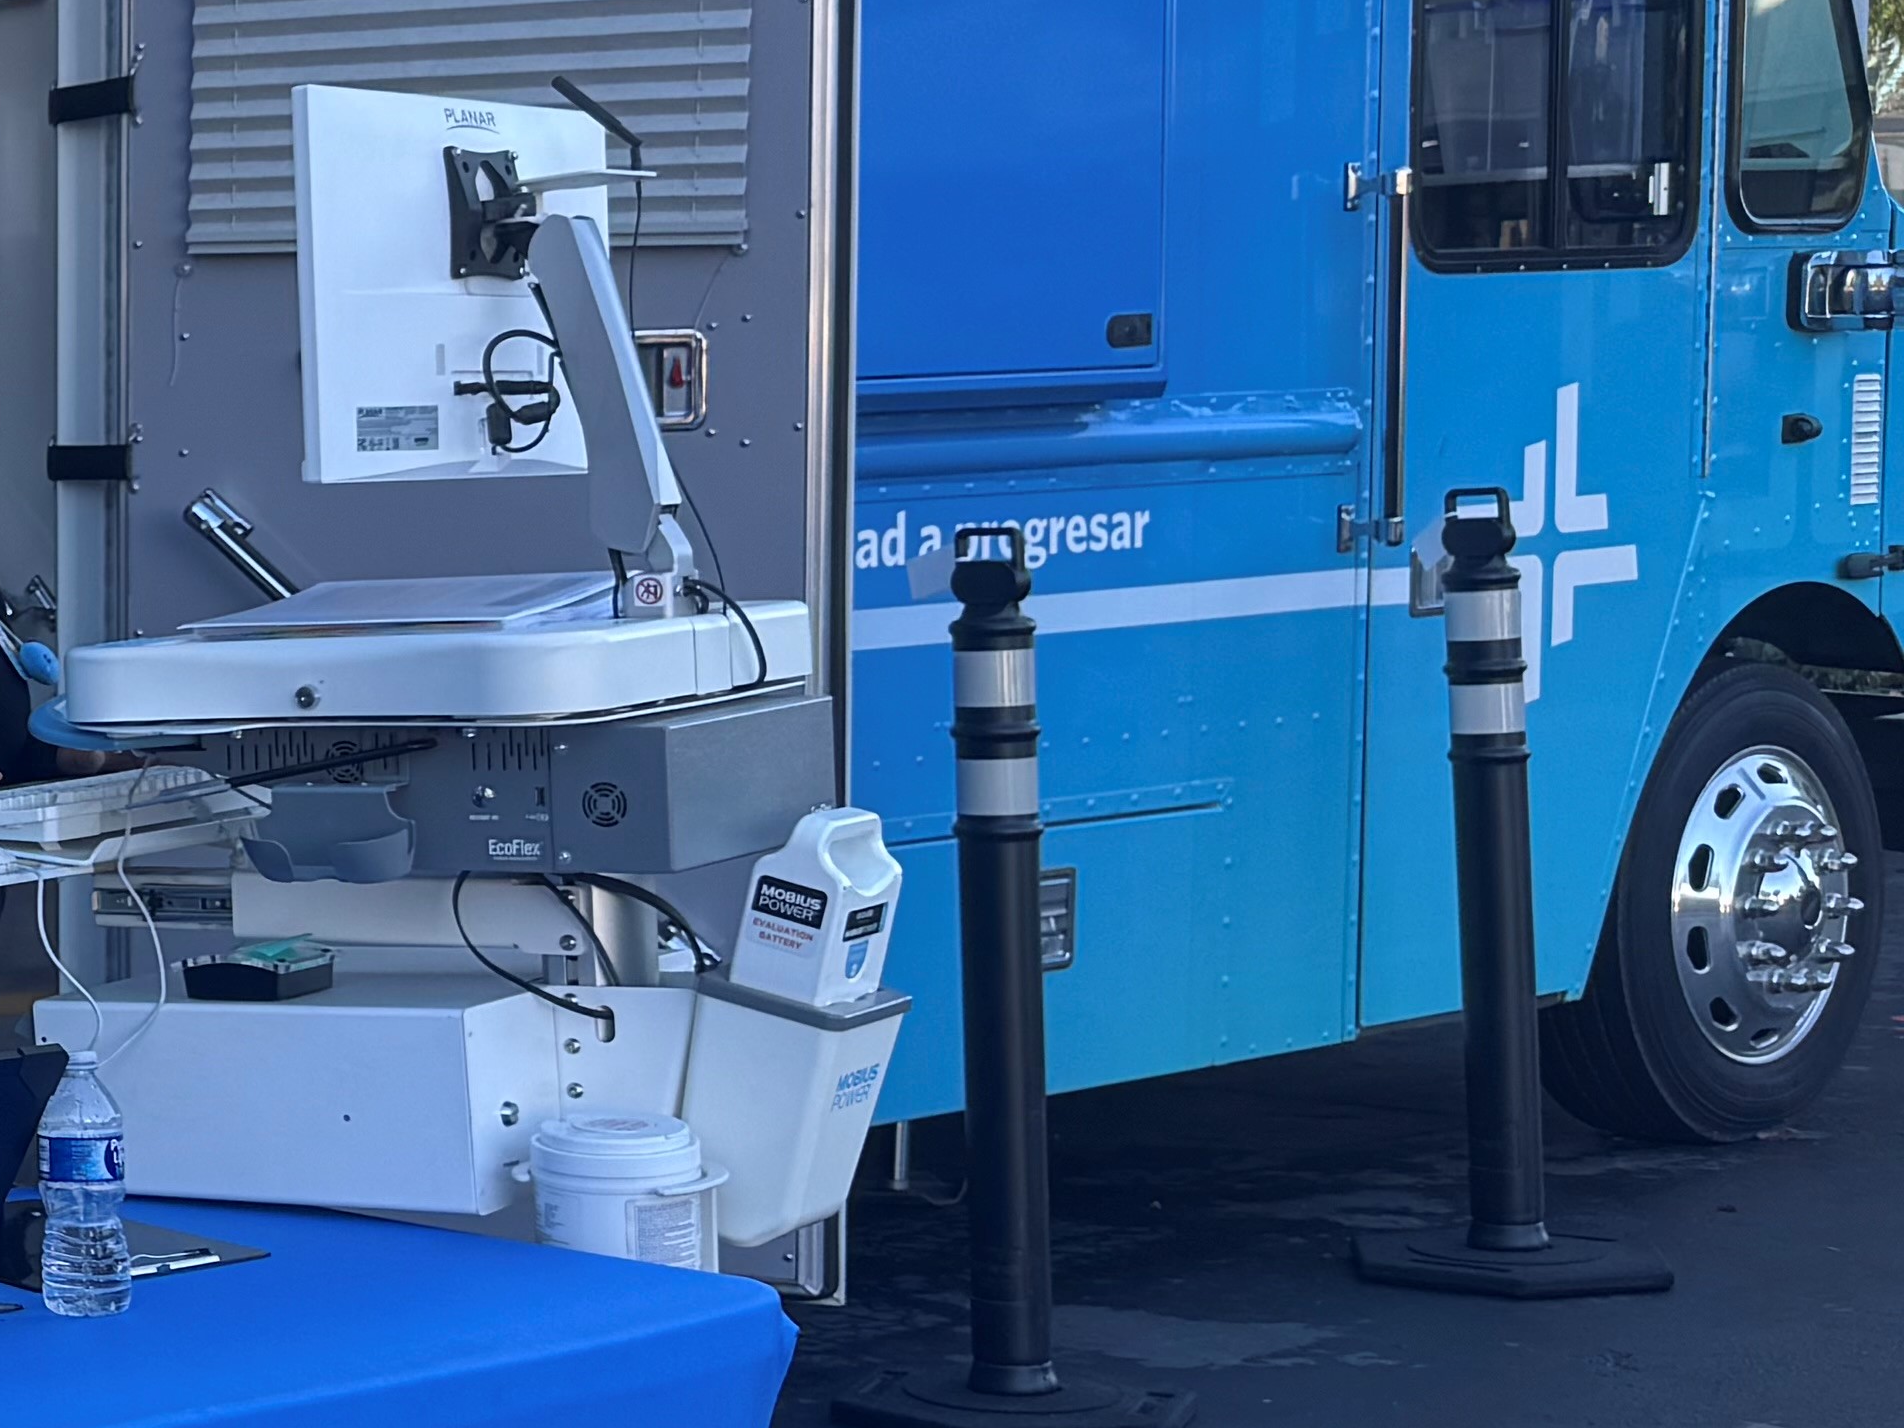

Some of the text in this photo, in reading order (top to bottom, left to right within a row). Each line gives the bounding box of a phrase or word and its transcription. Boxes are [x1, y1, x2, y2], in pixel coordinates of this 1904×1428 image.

[444, 108, 496, 127] PLANAR
[758, 895, 814, 922] POWER
[759, 884, 822, 910] MOBIUS
[752, 917, 814, 942] EVALUATION
[758, 930, 803, 950] BATTERY
